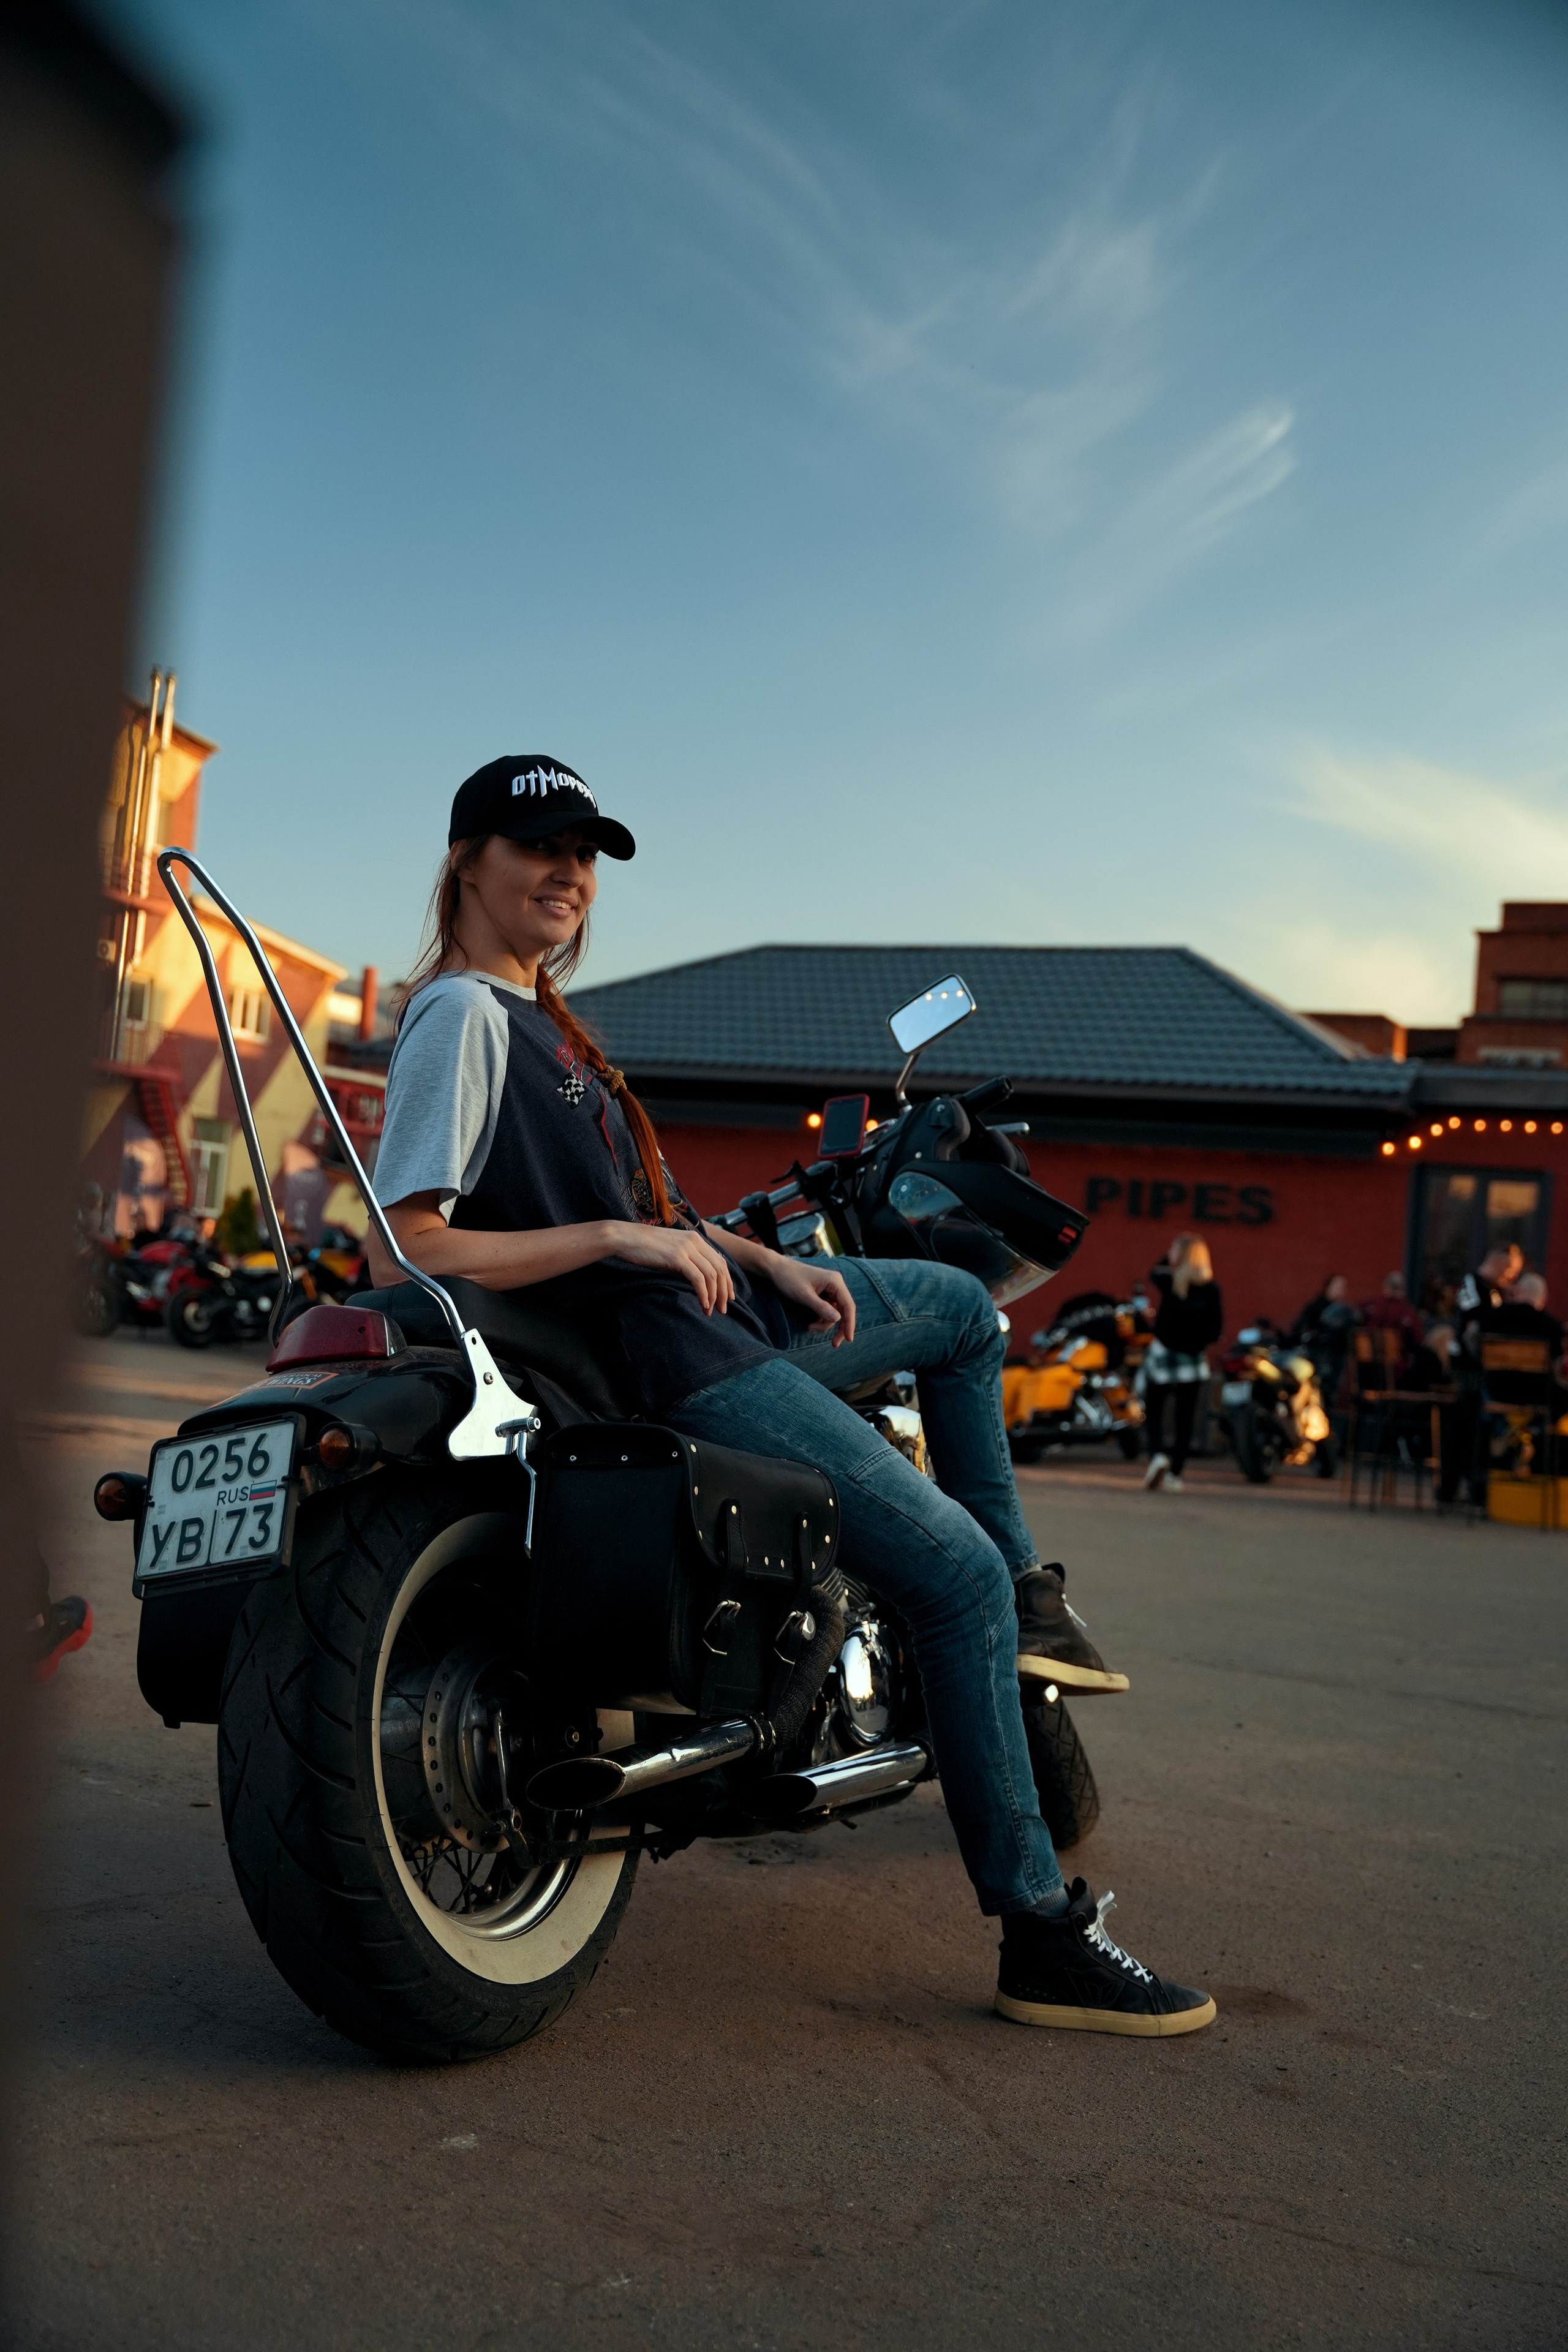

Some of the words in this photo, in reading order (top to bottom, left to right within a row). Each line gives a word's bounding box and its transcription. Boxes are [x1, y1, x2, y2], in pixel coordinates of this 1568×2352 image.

[1085, 1175, 1275, 1226] PIPES
[172, 1433, 270, 1493] 0256
[216, 1485, 249, 1506] RUS
[225, 1502, 274, 1555] 73
